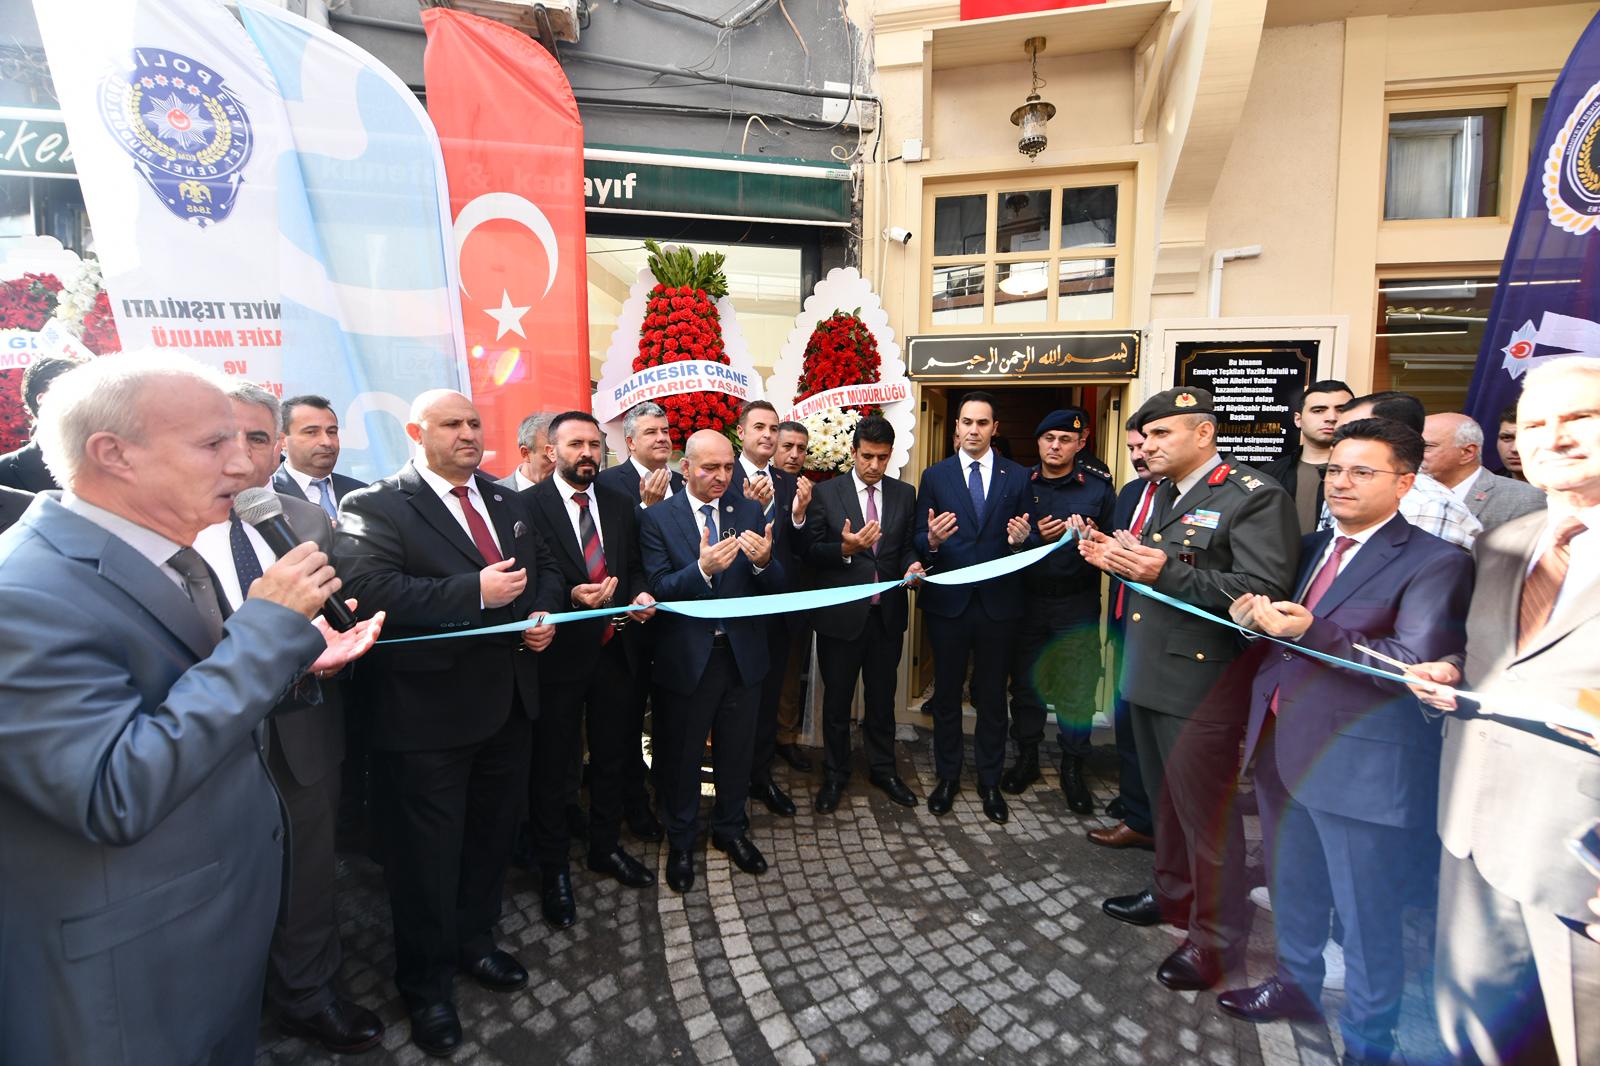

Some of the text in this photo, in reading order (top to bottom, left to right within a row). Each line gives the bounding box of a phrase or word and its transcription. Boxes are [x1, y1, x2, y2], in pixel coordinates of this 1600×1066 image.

[921, 342, 1128, 374] بسم الله الرحمن الرحيم
[1219, 368, 1245, 376] Teşkilatı
[614, 363, 749, 401] BALIKESİR CRANE
[619, 379, 703, 411] KURTARICI
[792, 407, 801, 421] İL
[803, 391, 845, 417] EMNİYET
[847, 384, 906, 404] MÜDÜRLÜĞÜ
[1262, 405, 1289, 413] Belediye
